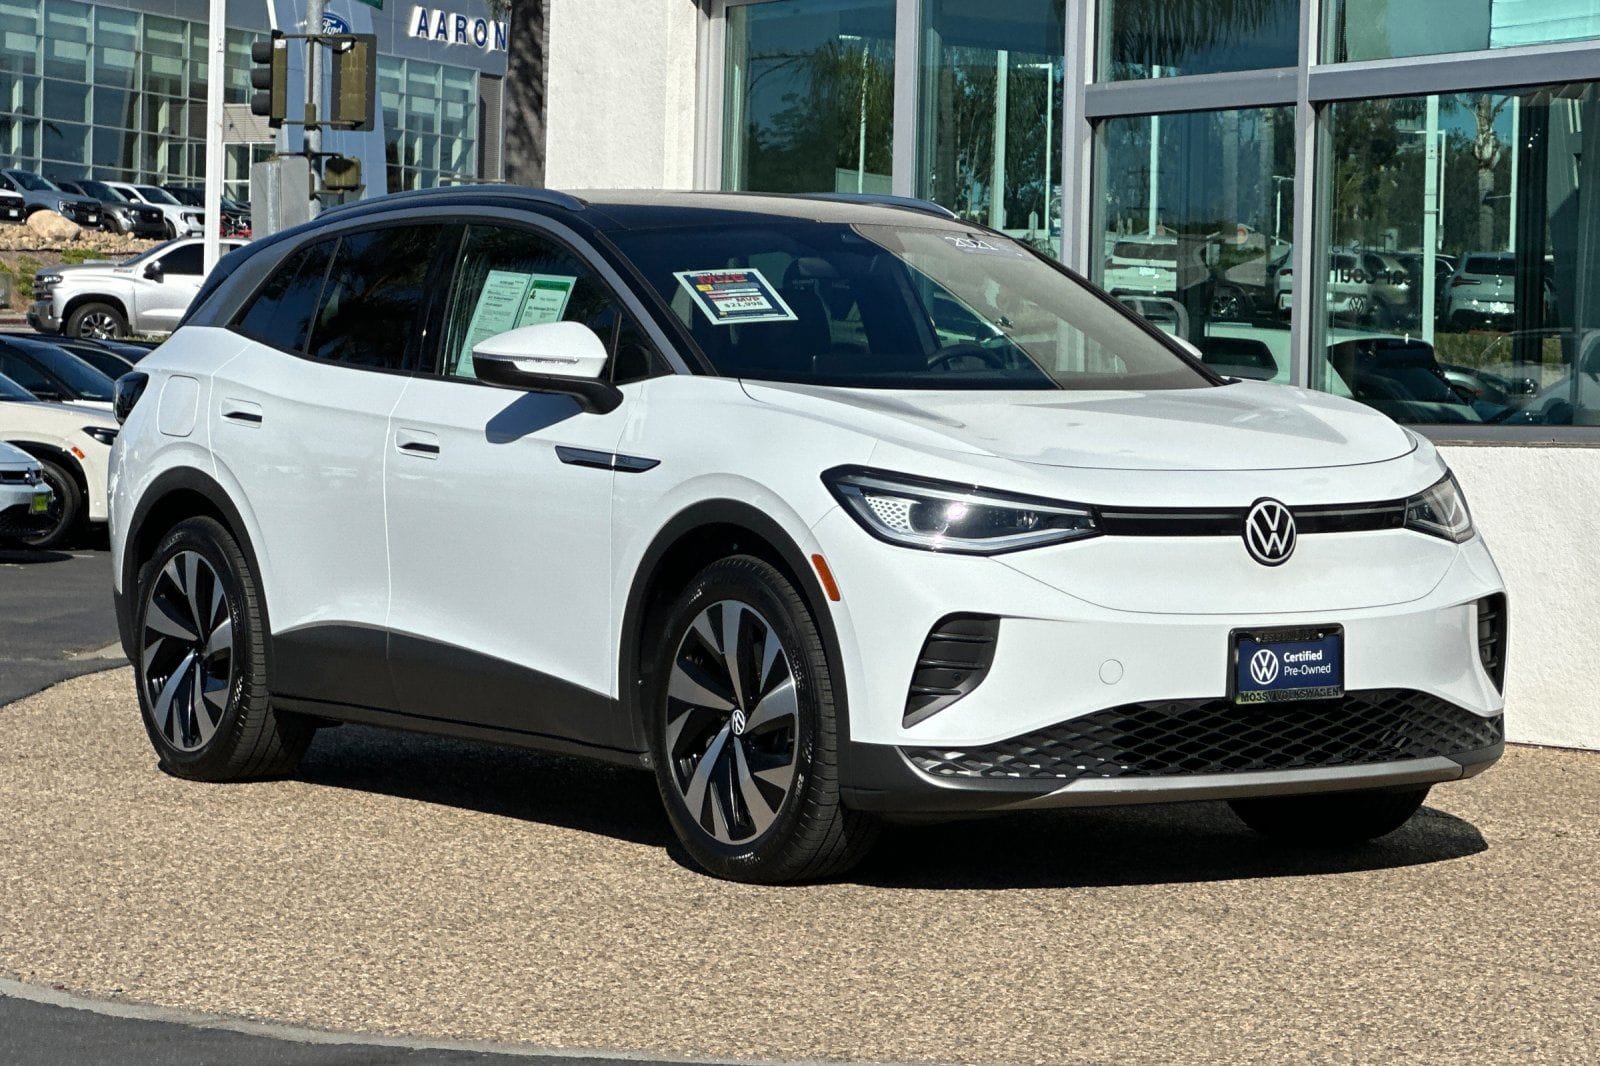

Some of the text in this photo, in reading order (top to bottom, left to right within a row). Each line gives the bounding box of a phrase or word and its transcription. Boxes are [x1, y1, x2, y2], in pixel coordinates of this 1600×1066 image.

[409, 6, 507, 51] AARON
[1283, 649, 1323, 663] Certified
[1284, 662, 1332, 676] Pre-Owned
[1240, 690, 1274, 703] MOSSY
